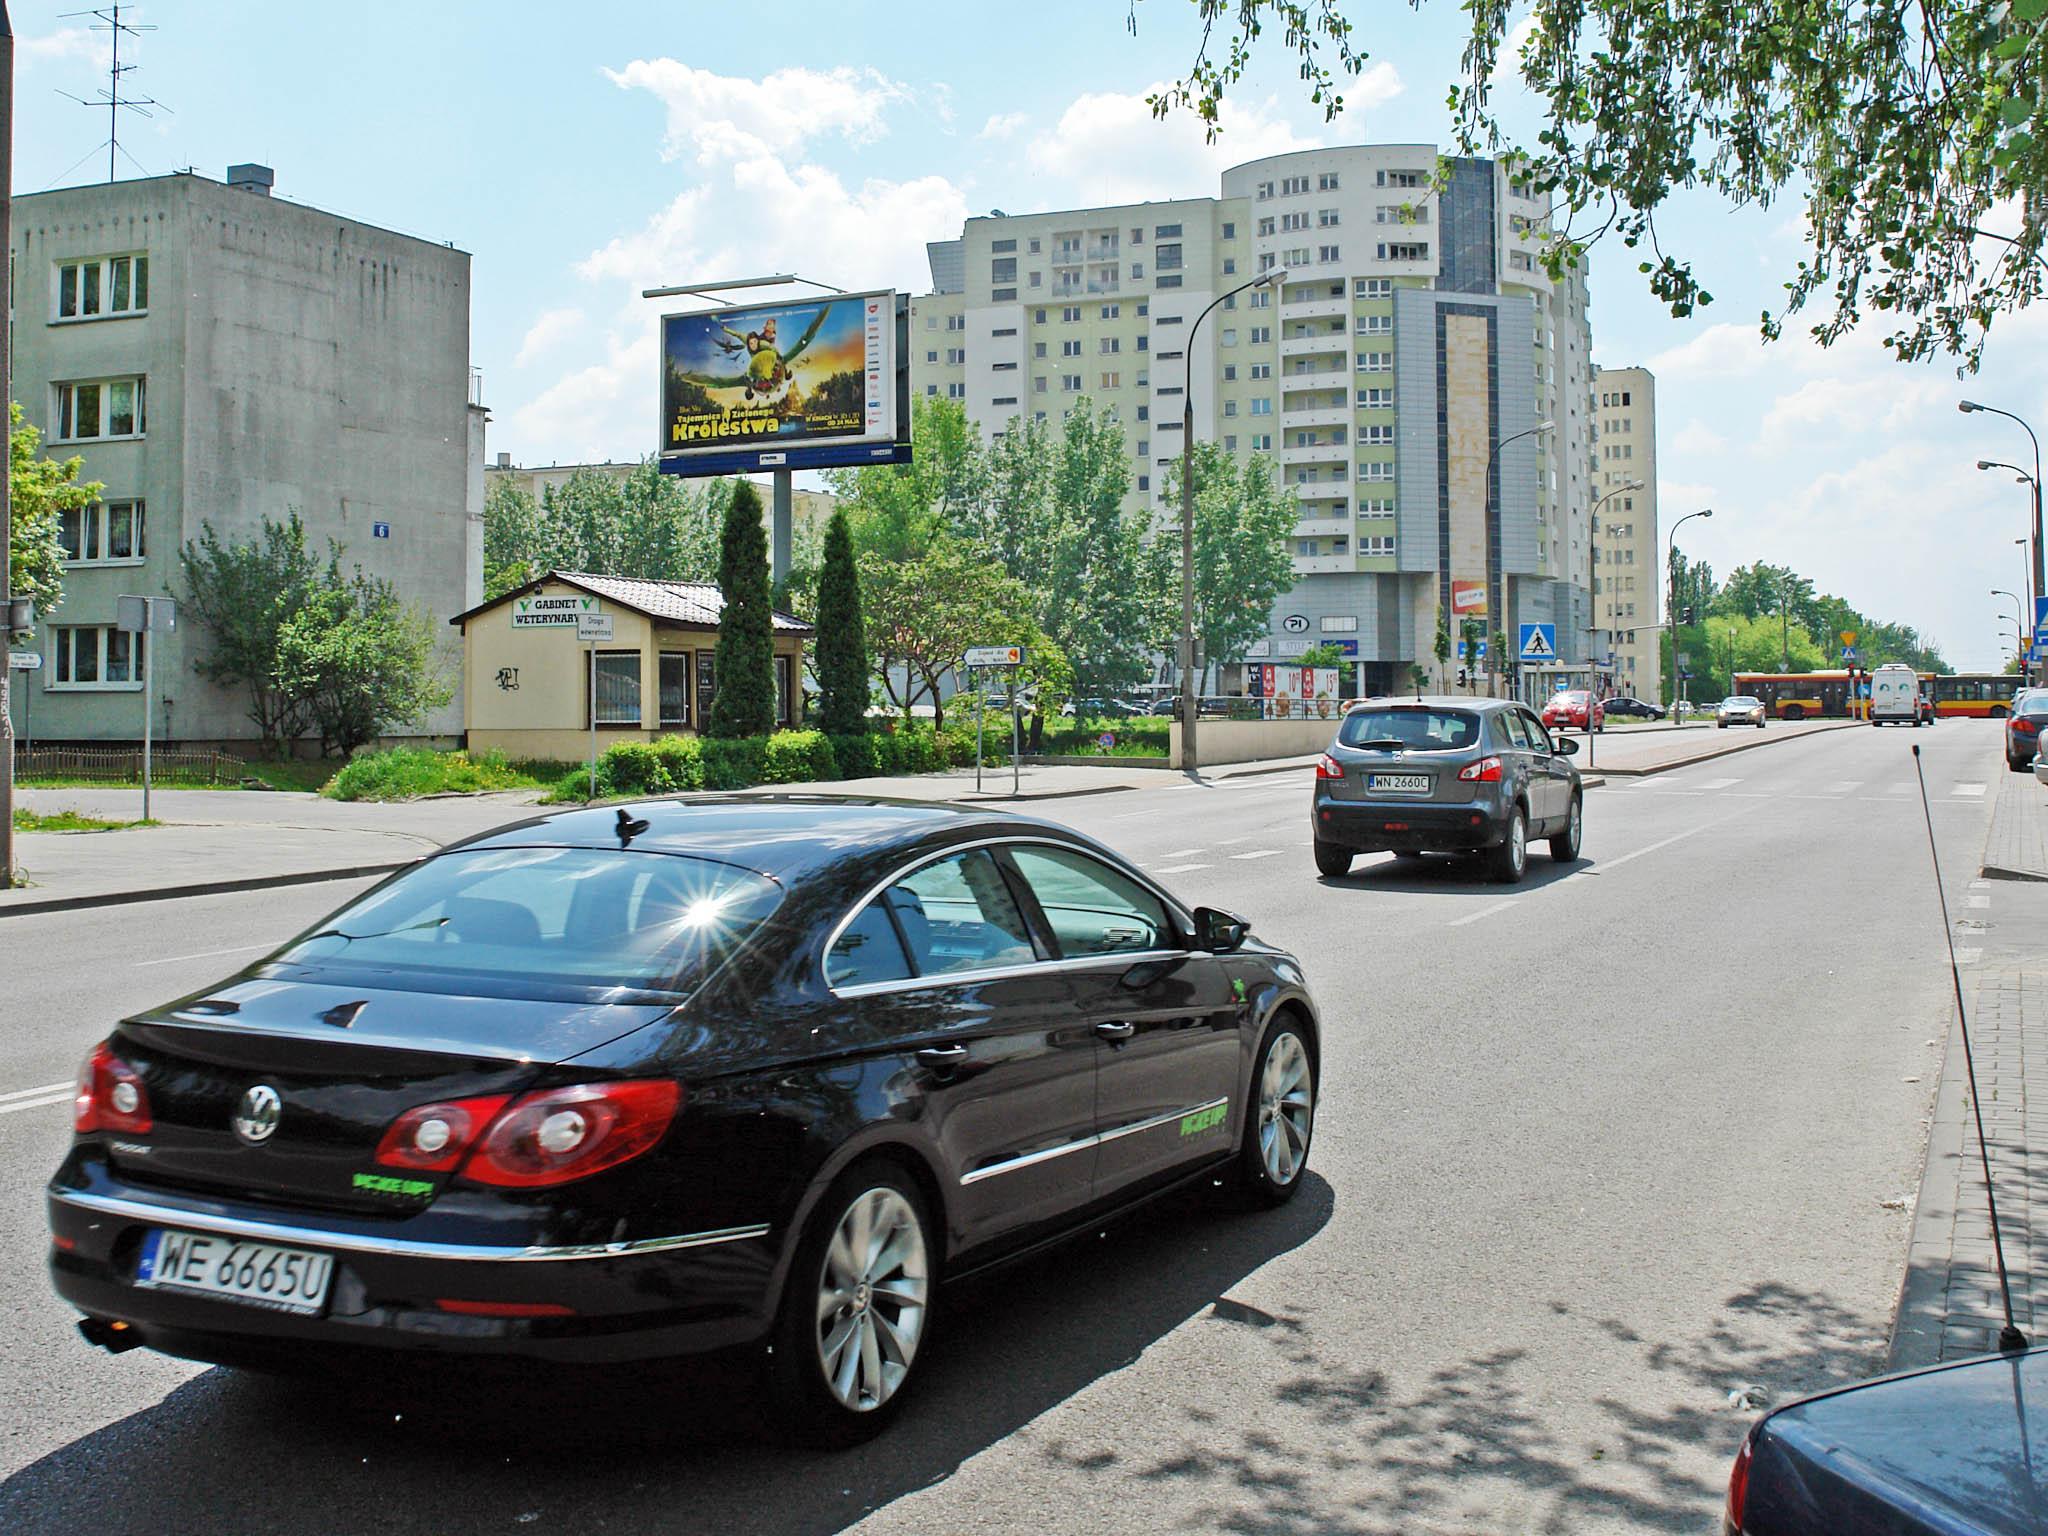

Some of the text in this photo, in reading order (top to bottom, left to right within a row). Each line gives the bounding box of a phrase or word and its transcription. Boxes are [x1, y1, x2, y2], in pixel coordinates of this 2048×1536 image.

[677, 408, 775, 424] Tajemnica Zielonego
[672, 418, 779, 441] Królestwa
[379, 526, 385, 537] 6
[535, 600, 578, 610] GABINET
[1375, 777, 1427, 788] WN 2660C
[160, 1235, 331, 1300] WE 6665U
